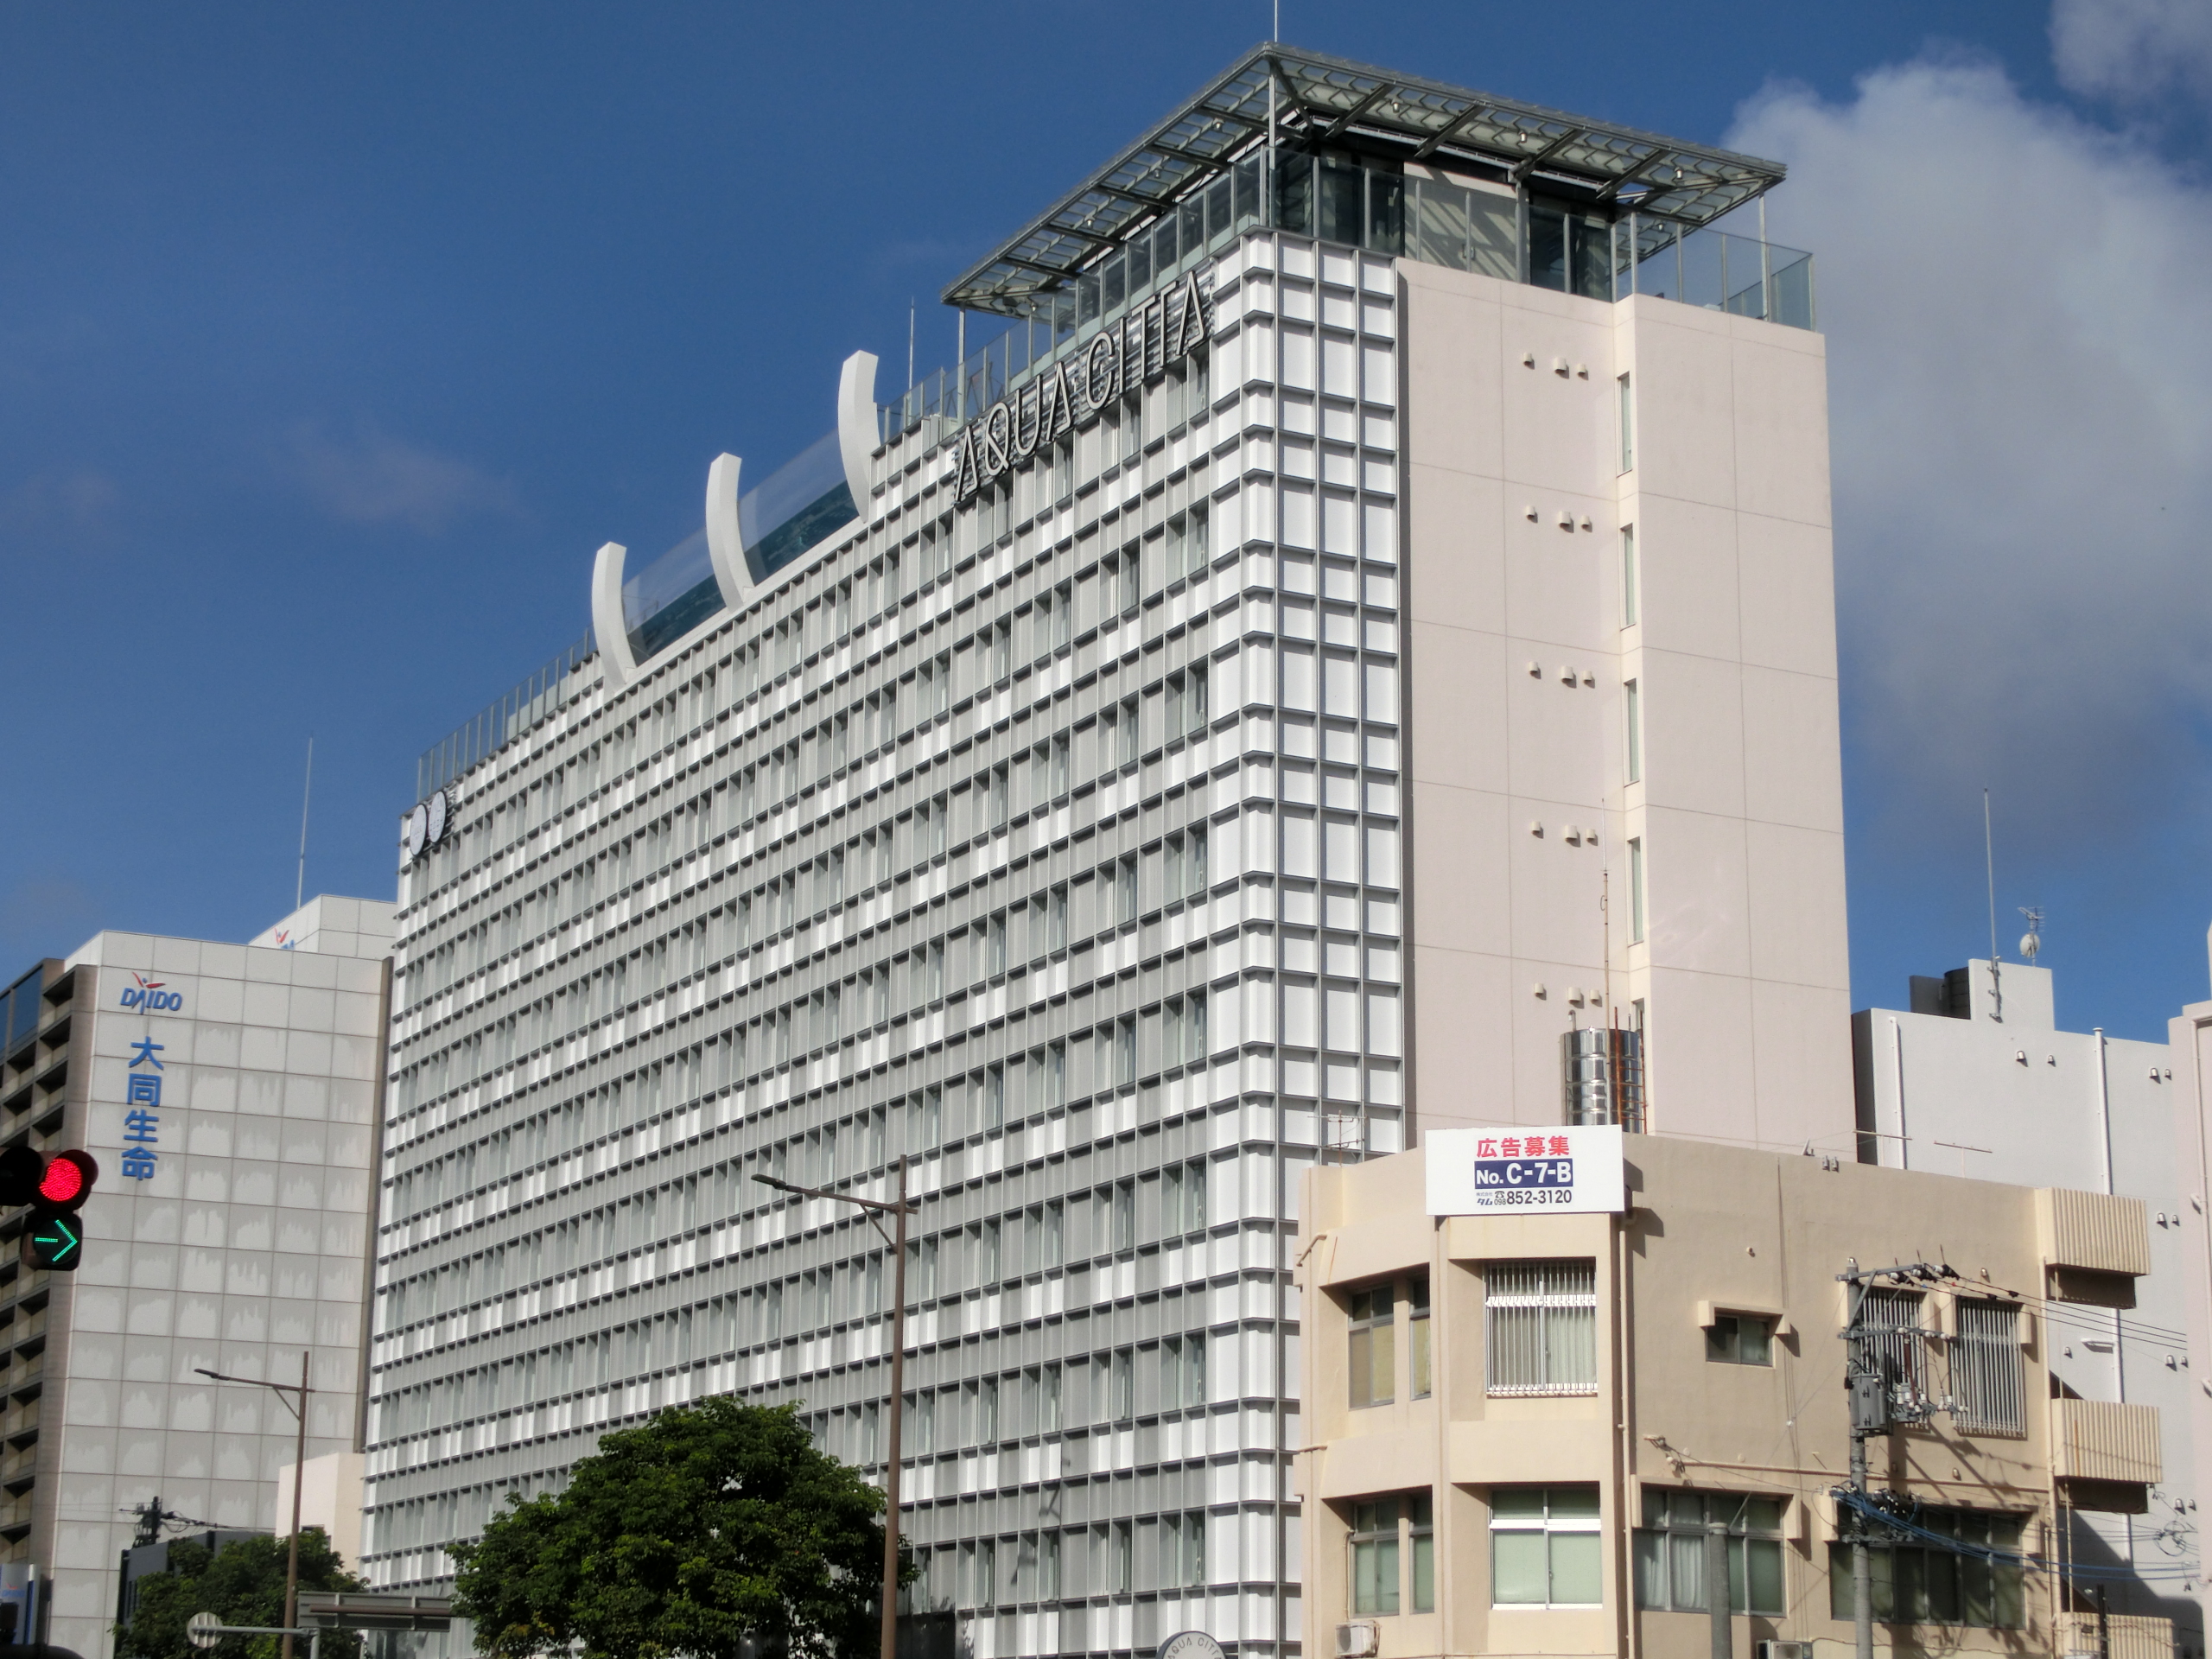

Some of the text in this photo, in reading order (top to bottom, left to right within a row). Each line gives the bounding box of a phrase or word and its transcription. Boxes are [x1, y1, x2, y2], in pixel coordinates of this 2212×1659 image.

[954, 270, 1205, 502] AQUA CITTA
[120, 988, 182, 1015] DAIDO
[121, 1036, 164, 1180] 大同生命
[1476, 1135, 1570, 1158] 広告募集
[1477, 1198, 1493, 1206] タム
[1506, 1189, 1572, 1205] 852-3120
